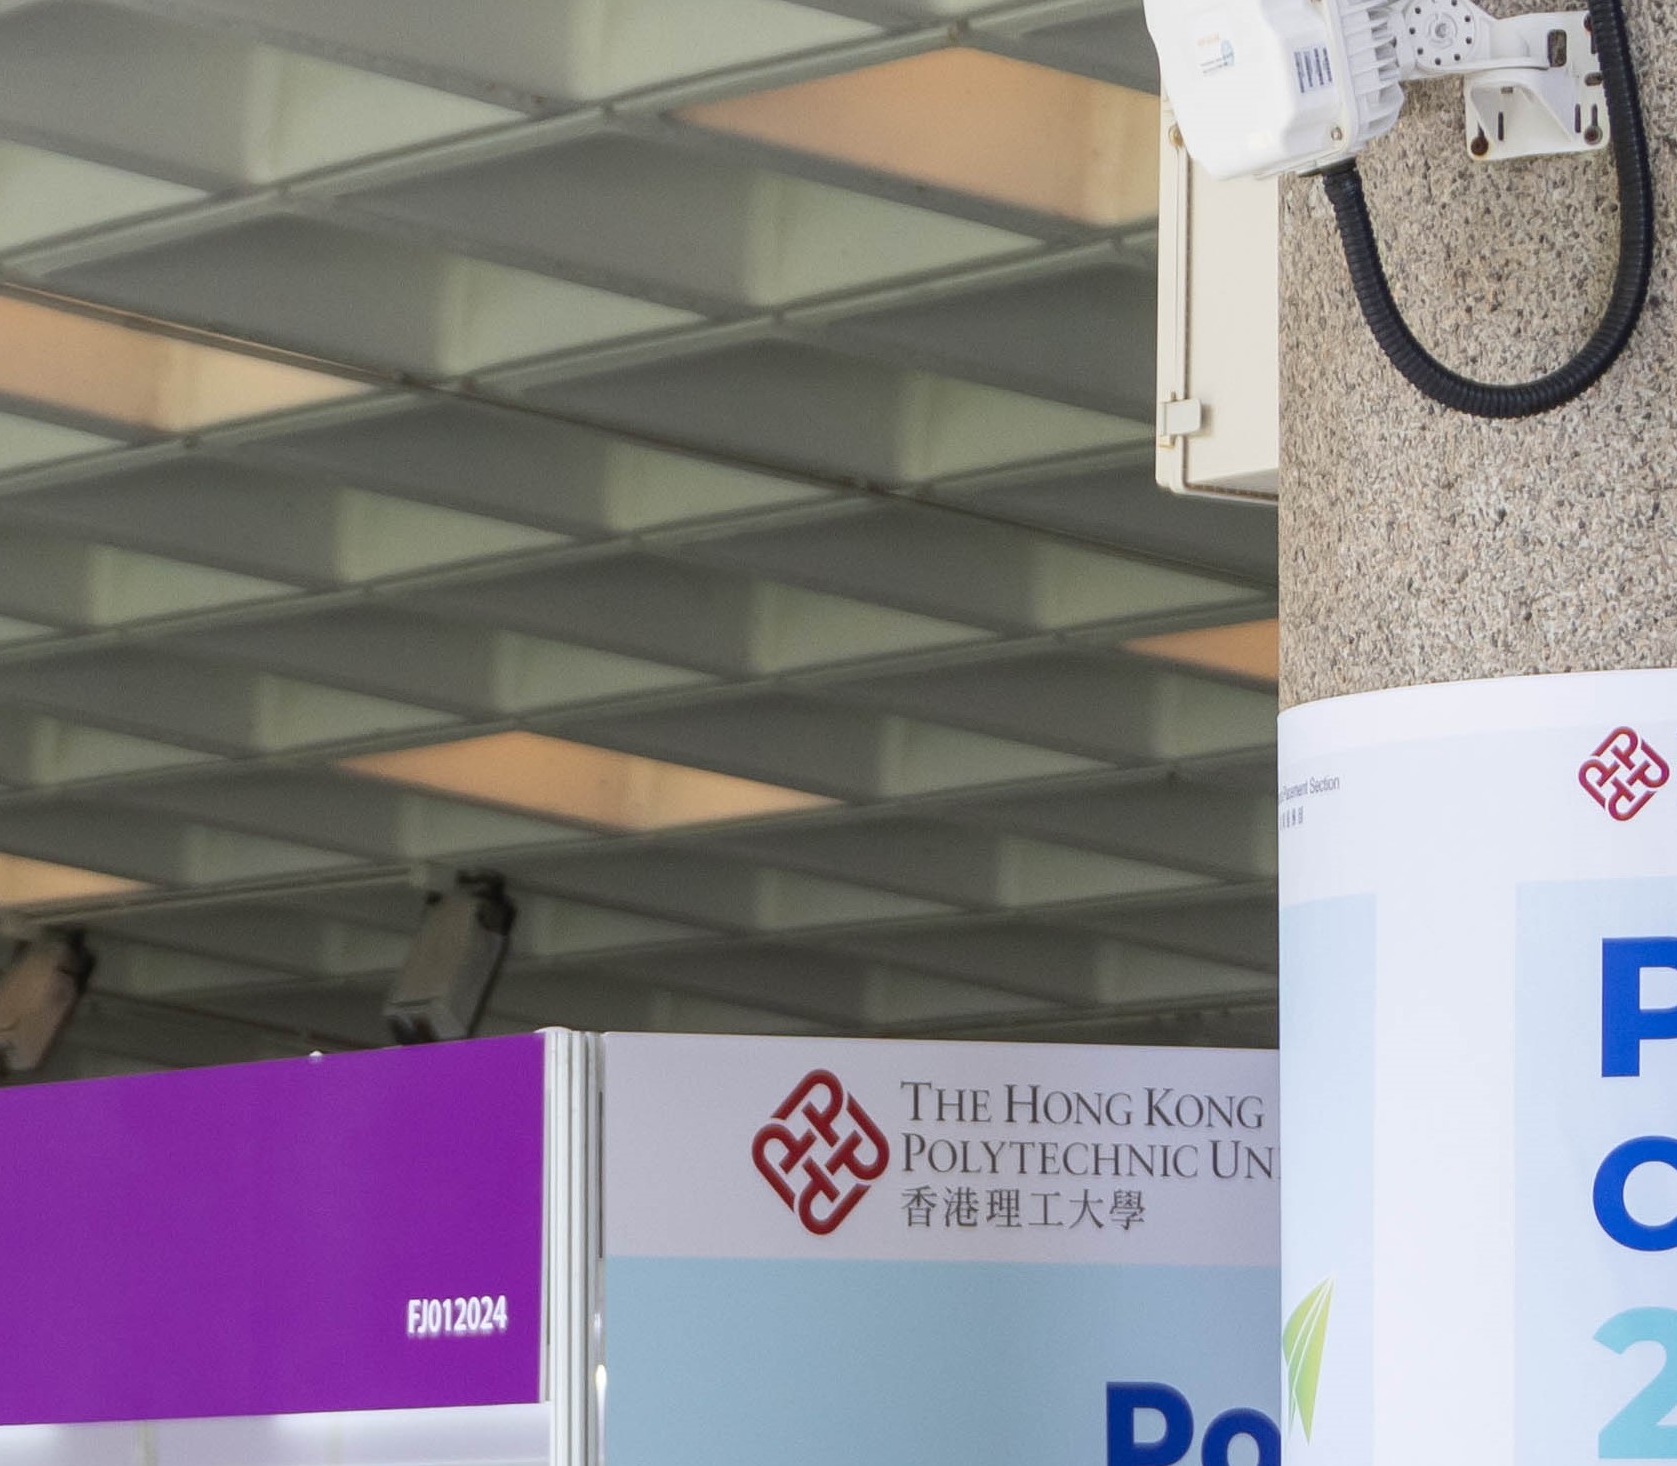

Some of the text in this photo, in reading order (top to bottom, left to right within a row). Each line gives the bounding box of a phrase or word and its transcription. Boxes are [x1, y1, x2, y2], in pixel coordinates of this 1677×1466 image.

[901, 1081, 1264, 1128] THE HONG KONG
[901, 1133, 1198, 1178] POLYTECHNIC
[901, 1188, 1145, 1231] 香港理工大學
[407, 1296, 507, 1334] FJ012024
